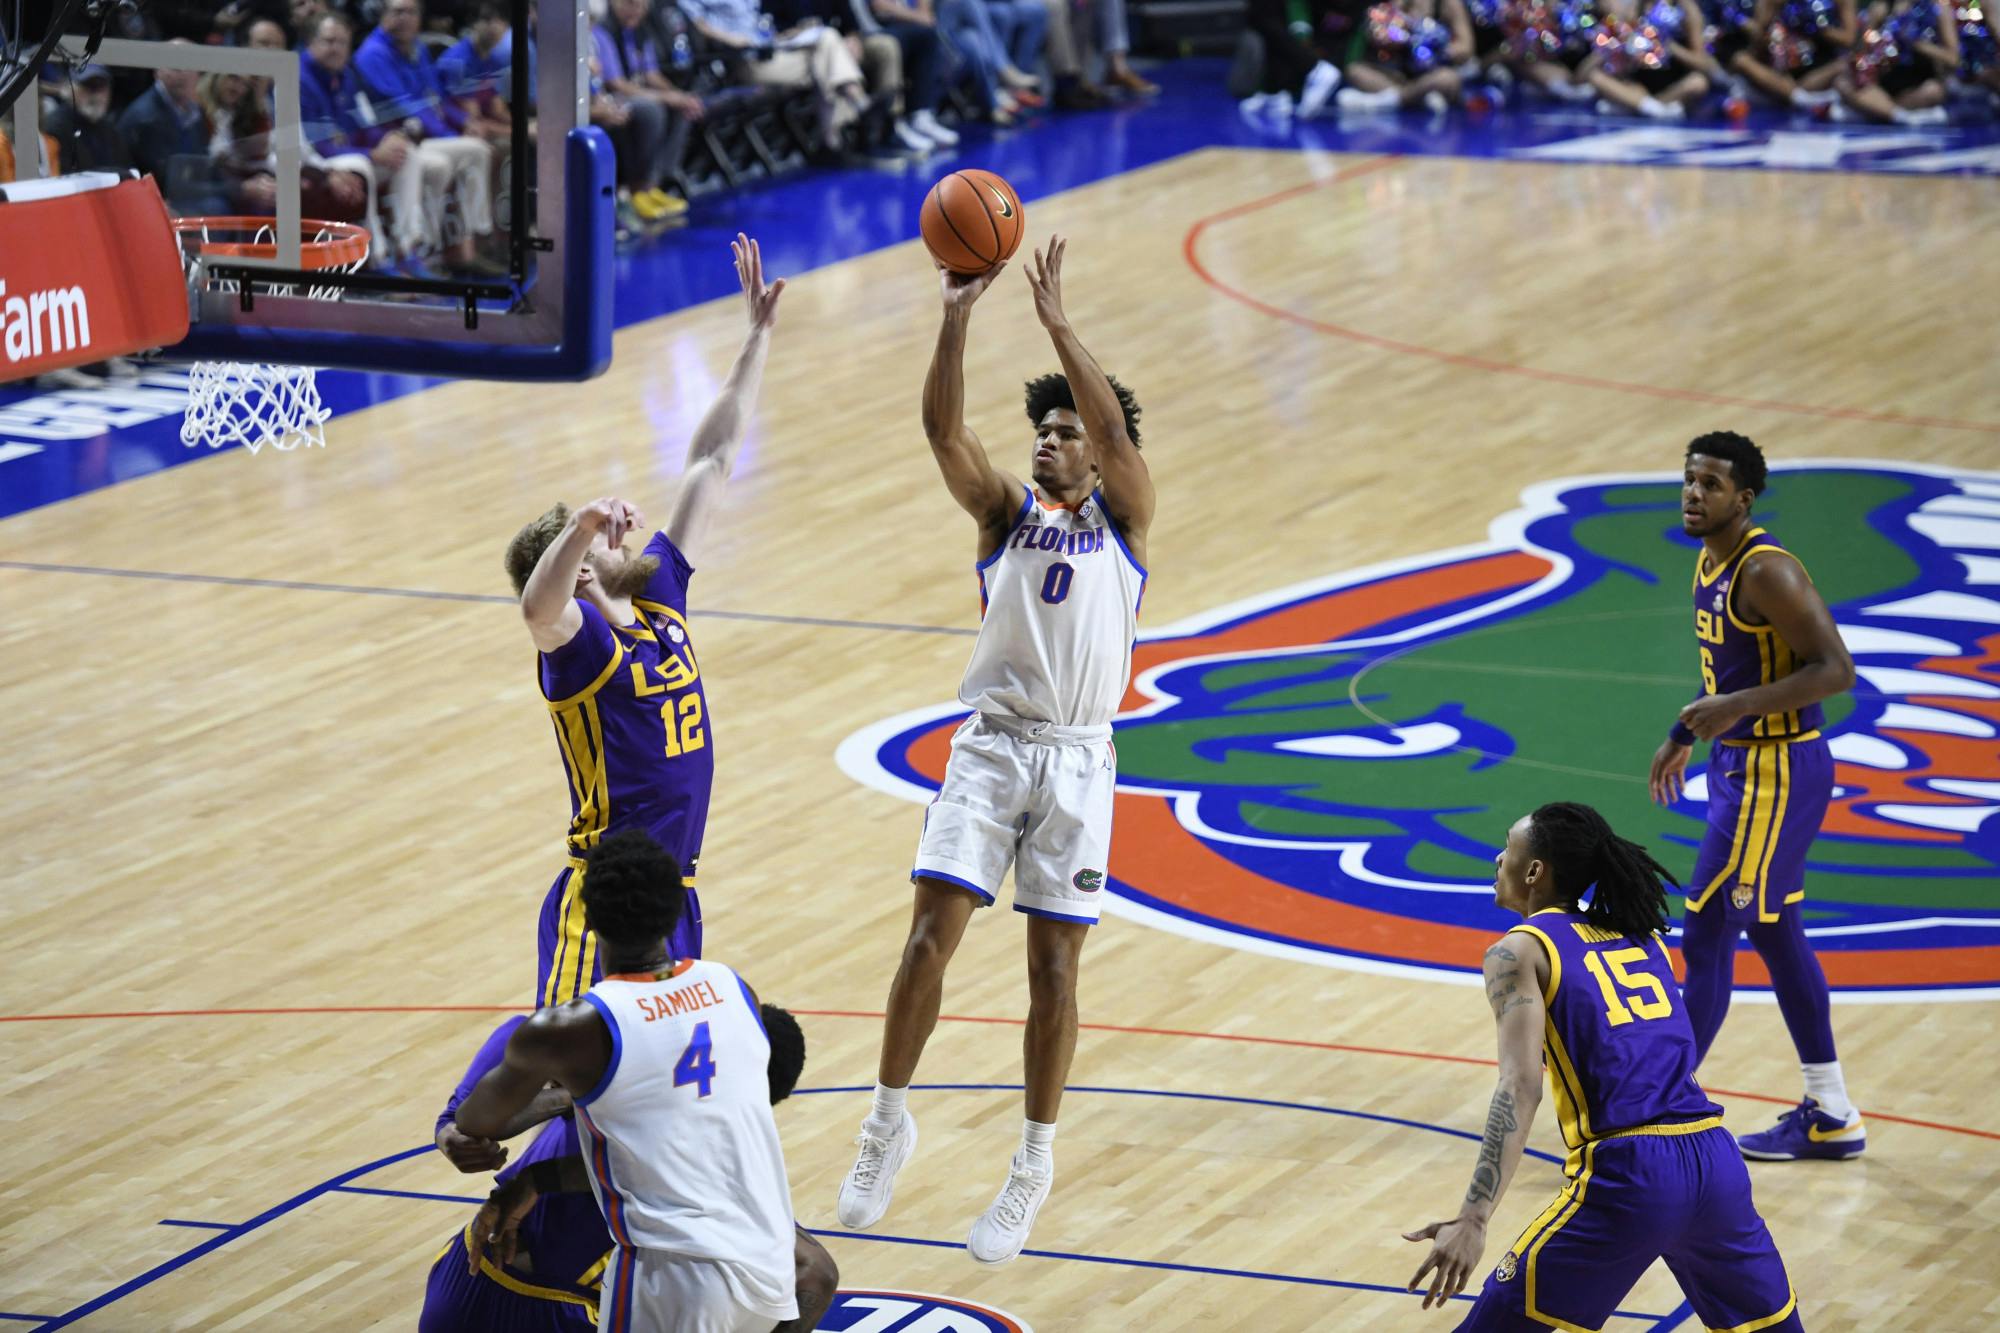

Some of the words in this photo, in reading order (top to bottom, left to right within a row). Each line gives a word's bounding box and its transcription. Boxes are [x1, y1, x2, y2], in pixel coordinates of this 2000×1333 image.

[1010, 525, 1104, 556] FLORIDA
[1040, 562, 1075, 604] 0
[1695, 608, 1725, 645] SU
[630, 644, 699, 697] LSU
[1700, 646, 1717, 696] 6
[660, 692, 705, 758] 12
[636, 980, 724, 1022] SAMUEL
[1583, 947, 1672, 1027] 15
[673, 1021, 716, 1098] 4
